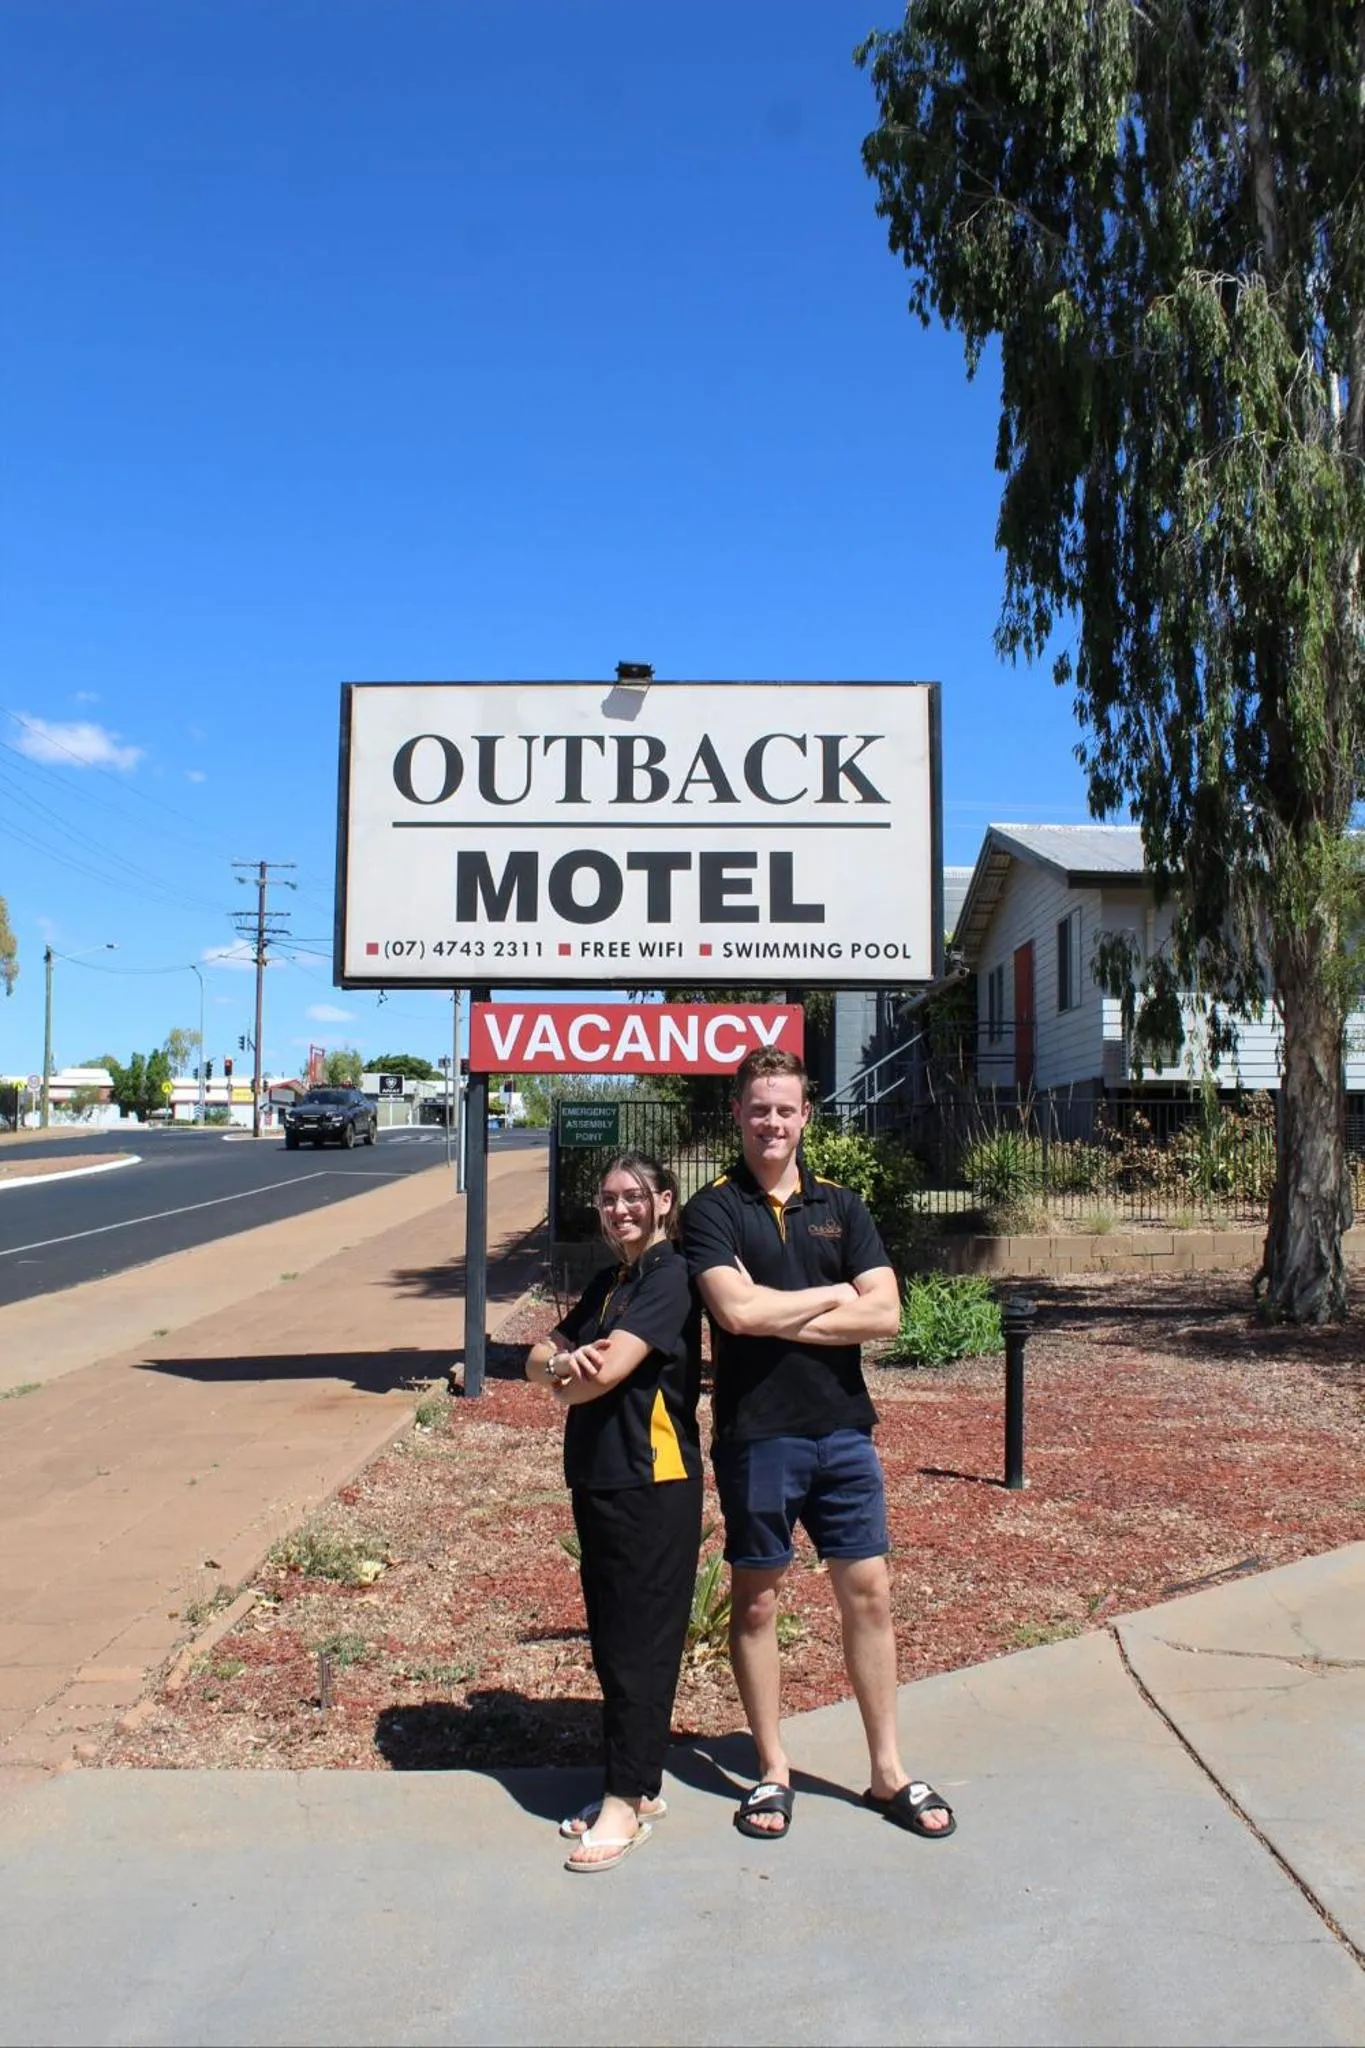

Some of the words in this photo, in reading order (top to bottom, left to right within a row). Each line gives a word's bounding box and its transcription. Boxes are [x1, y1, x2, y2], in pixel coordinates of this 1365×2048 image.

[392, 733, 891, 806] OUTBACK
[456, 849, 825, 925] MOTEL
[383, 940, 426, 959] (07)
[432, 940, 485, 957] 4743
[493, 940, 543, 957] 2311
[581, 941, 631, 958] FREE
[638, 941, 684, 958] WIFI
[722, 941, 843, 959] SWIMMING
[851, 941, 912, 959] POOL
[483, 1013, 789, 1063] VACANCY
[562, 1107, 617, 1116] EMERGENCY
[566, 1120, 614, 1128] ASSEMBLY
[575, 1133, 602, 1141] POINT
